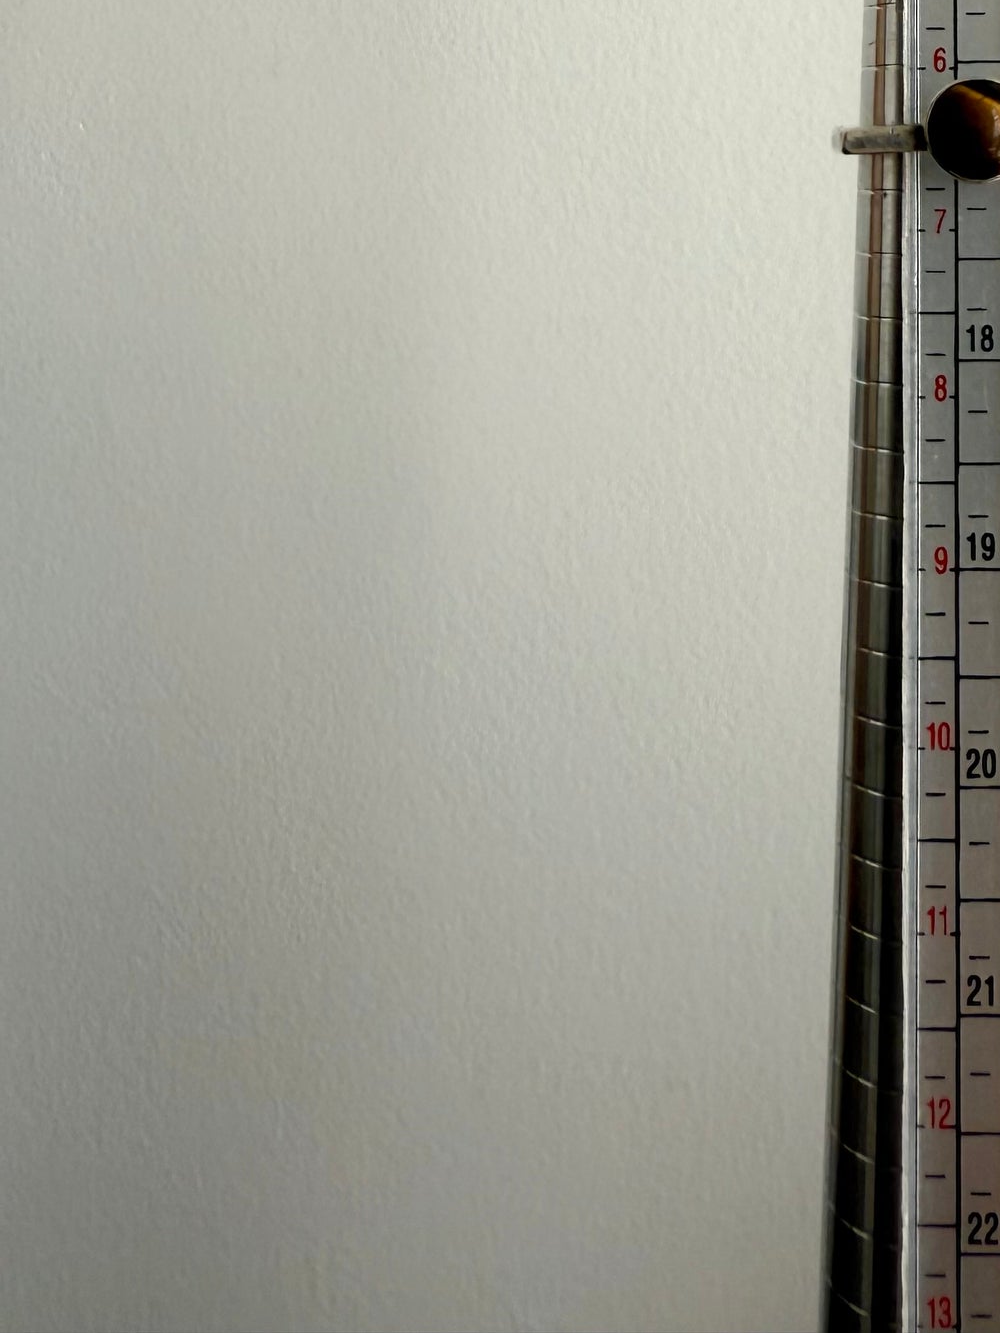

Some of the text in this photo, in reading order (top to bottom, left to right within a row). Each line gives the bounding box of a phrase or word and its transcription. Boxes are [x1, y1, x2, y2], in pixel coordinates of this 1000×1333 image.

[933, 47, 947, 73] 6
[933, 209, 947, 234] 7
[965, 324, 994, 352] 18
[934, 374, 947, 402] 8
[934, 546, 948, 574] 9
[966, 532, 996, 561] 19
[926, 722, 951, 751] 10
[966, 748, 997, 779] 20
[927, 905, 947, 936] 11
[966, 974, 995, 1006] 21
[926, 1096, 951, 1129] 12
[967, 1211, 999, 1245] 22
[926, 1296, 951, 1329] 13
